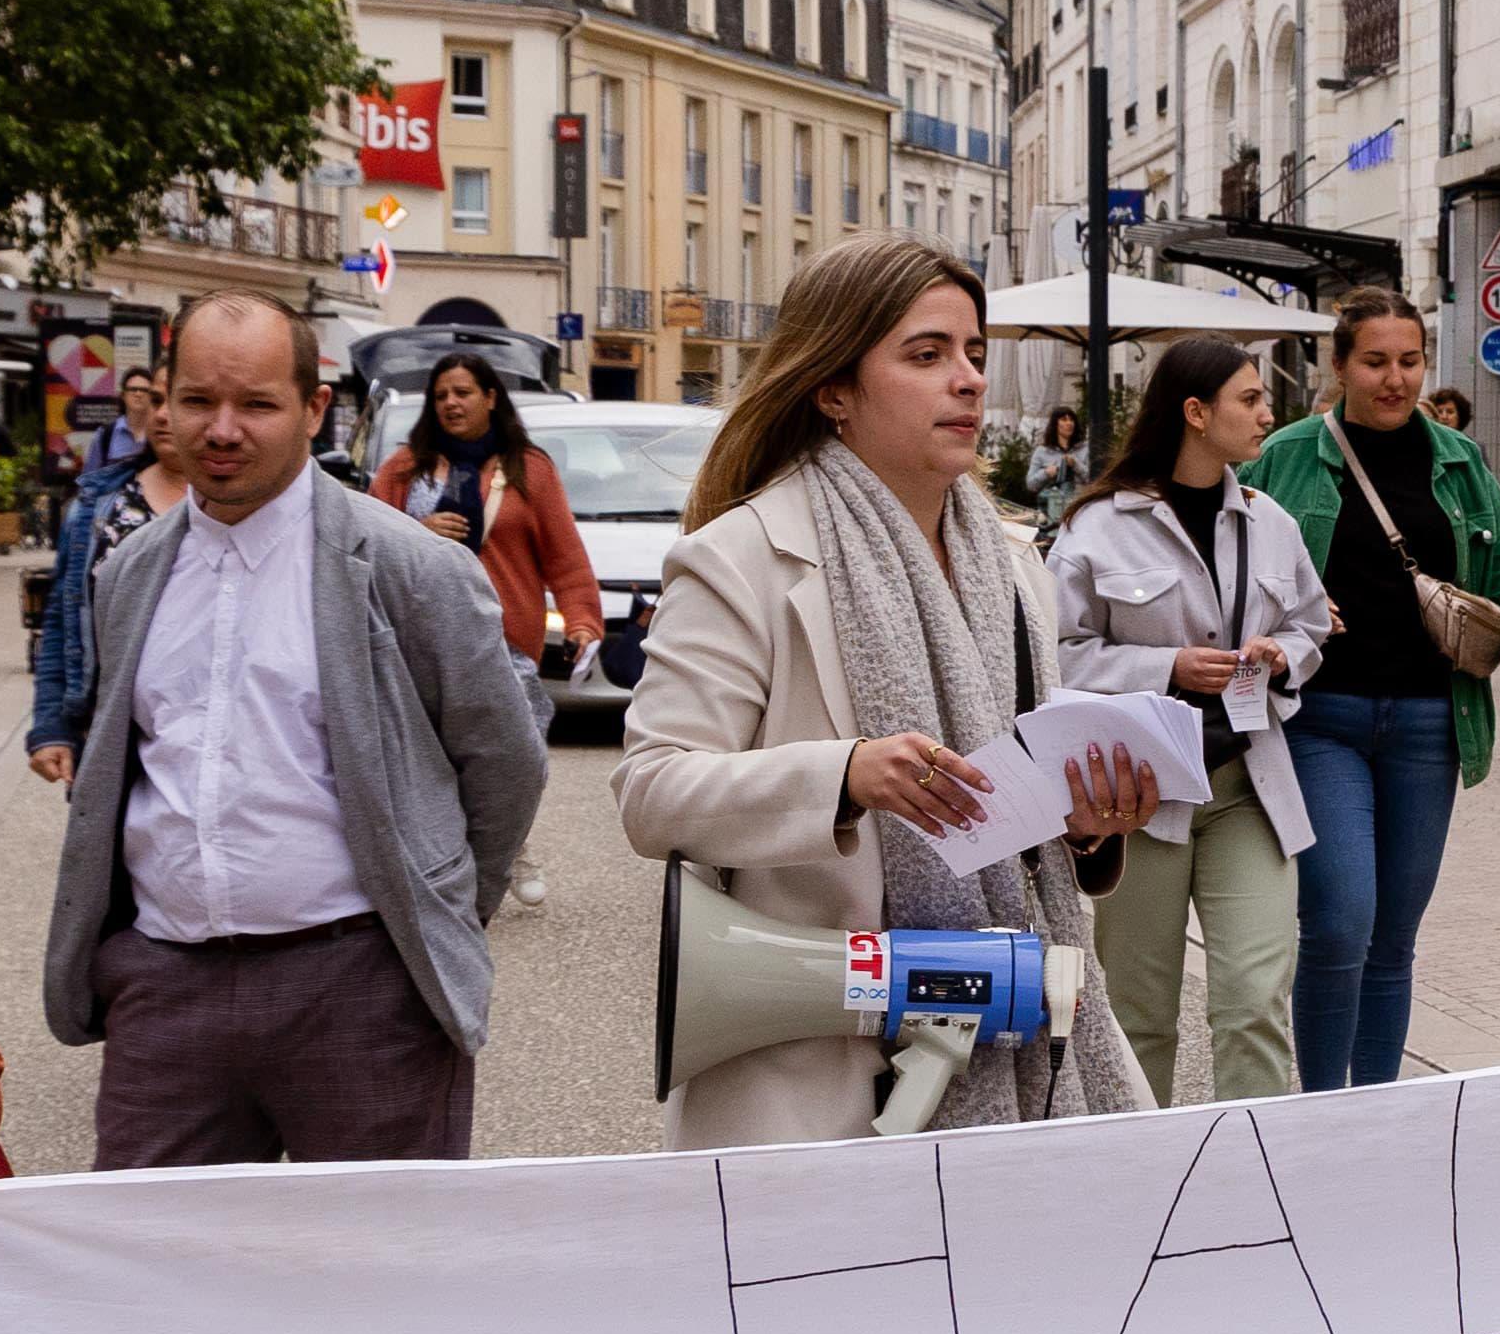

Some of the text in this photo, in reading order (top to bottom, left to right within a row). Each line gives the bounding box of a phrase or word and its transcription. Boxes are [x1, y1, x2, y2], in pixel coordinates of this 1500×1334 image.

[356, 103, 431, 152] ibis
[1234, 667, 1262, 679] STOP
[849, 931, 884, 981] GT
